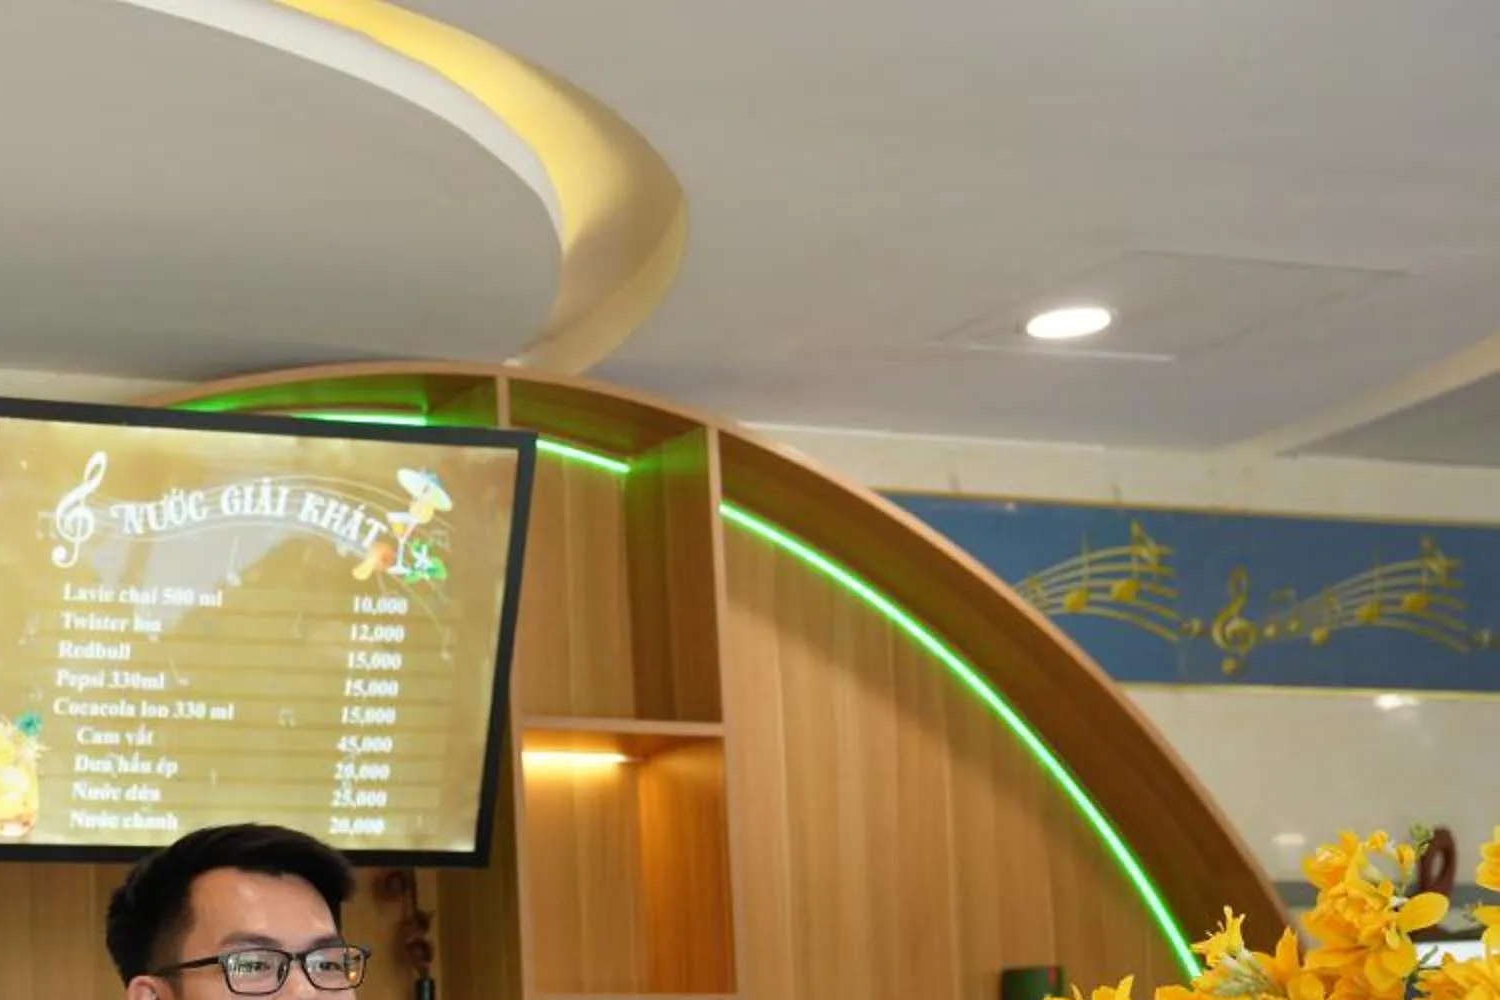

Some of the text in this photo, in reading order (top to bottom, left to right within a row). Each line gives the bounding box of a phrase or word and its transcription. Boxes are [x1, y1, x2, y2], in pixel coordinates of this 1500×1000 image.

[109, 477, 388, 549] NƯỚC GIẢI KHÁT
[63, 582, 114, 603] Lavie
[162, 586, 195, 606] 500
[199, 589, 223, 608] ml
[353, 595, 409, 616] 10,000
[61, 611, 130, 632] Twister
[350, 624, 405, 643] 12,000
[58, 640, 131, 661] Redbull
[347, 651, 403, 671] 15,000
[56, 668, 105, 693] Pepsi
[344, 679, 399, 699] 15,000
[53, 698, 136, 718] Cocacola
[172, 701, 206, 720] 330
[210, 703, 235, 720] ml
[341, 706, 397, 727] 15,000
[76, 727, 120, 744] Cam
[336, 735, 393, 755] 45,000
